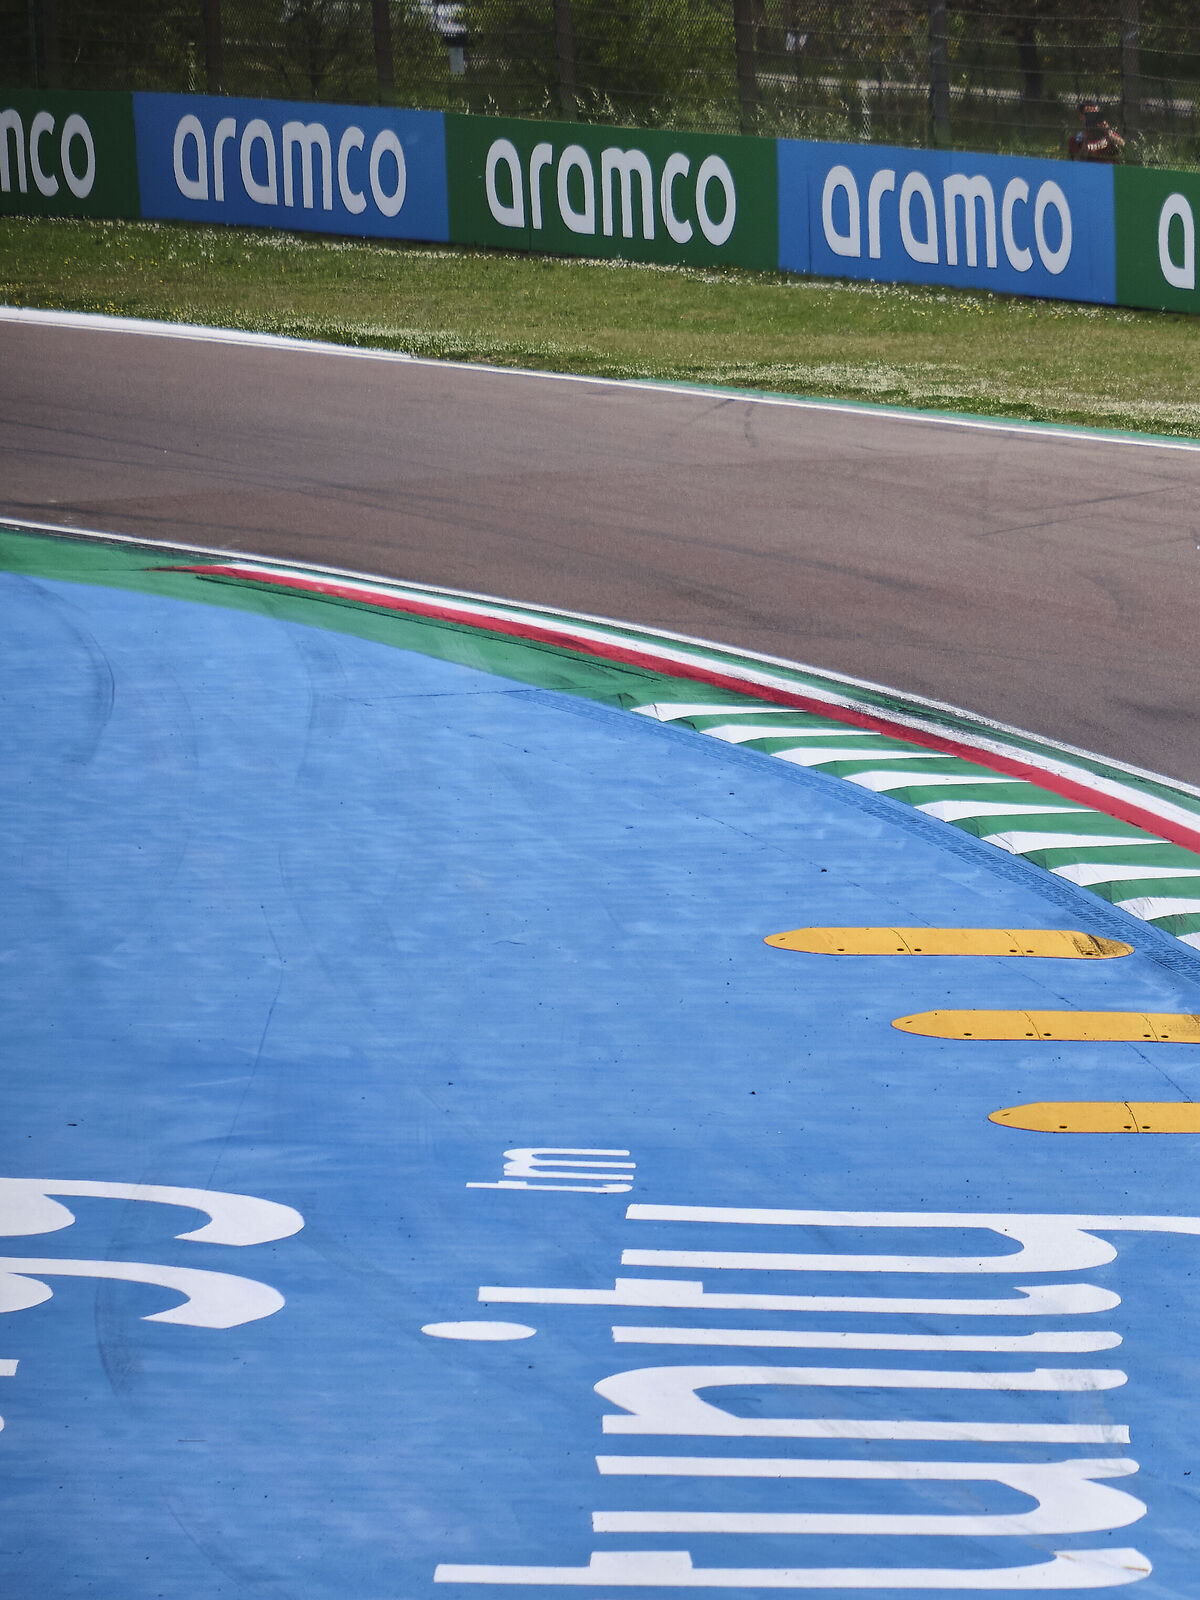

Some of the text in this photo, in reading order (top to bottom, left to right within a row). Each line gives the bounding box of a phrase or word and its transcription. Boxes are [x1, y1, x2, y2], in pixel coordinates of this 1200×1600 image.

[173, 114, 407, 218] aramco
[485, 139, 737, 246] aramco
[822, 165, 1073, 275] aramco
